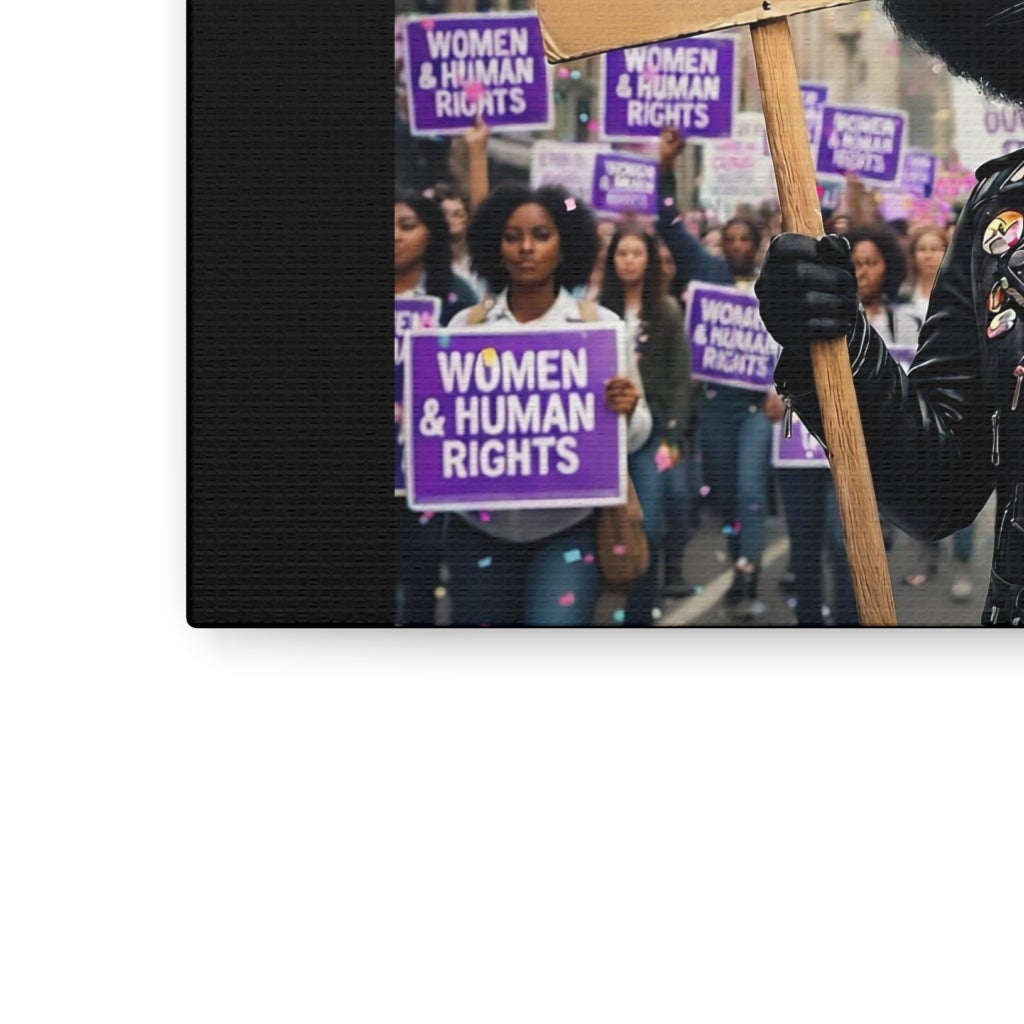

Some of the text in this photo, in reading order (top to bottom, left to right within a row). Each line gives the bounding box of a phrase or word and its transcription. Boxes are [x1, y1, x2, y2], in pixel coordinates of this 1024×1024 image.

[426, 27, 528, 59] WOMEN
[419, 57, 534, 90] & HUMAN
[624, 46, 718, 74] WOMEN
[616, 73, 720, 101] & HUMAN
[627, 99, 710, 129] RIGHTS
[437, 347, 588, 394] WOMEN
[702, 346, 768, 378] RIGHTS
[419, 392, 595, 437] & HUMAN
[442, 436, 580, 479] RIGHTS
